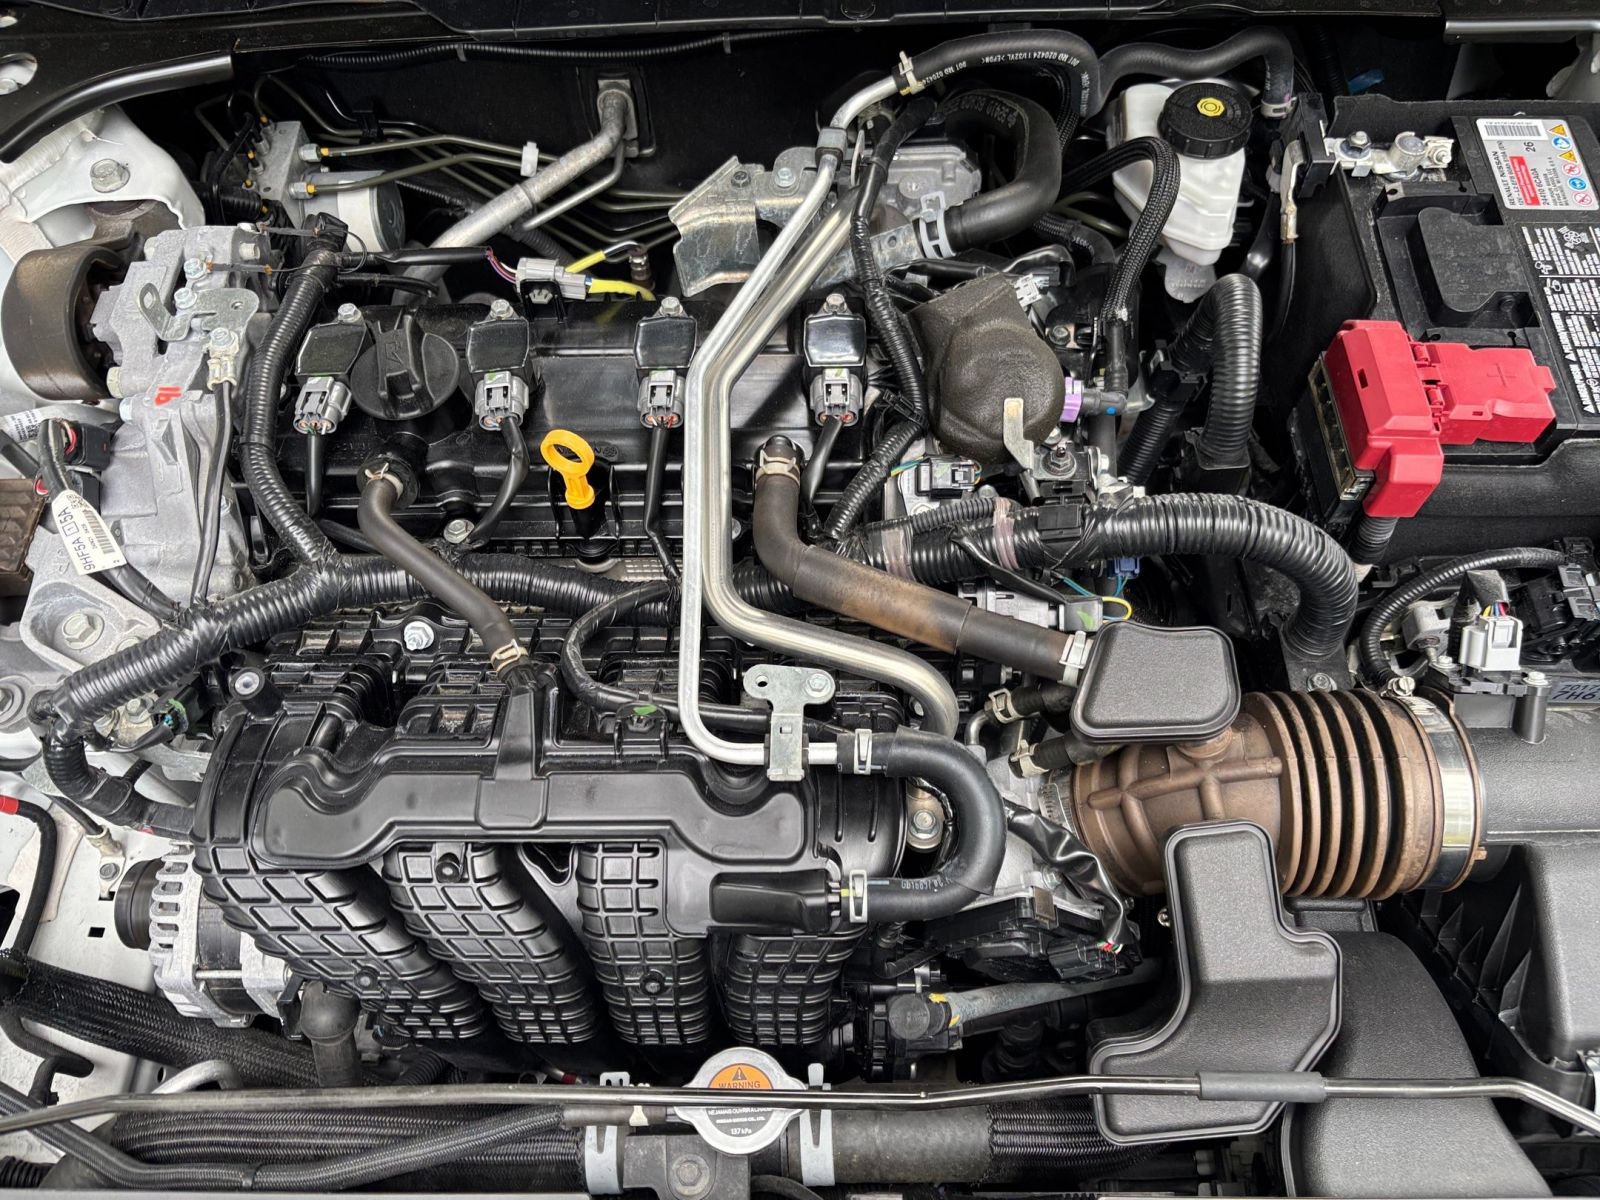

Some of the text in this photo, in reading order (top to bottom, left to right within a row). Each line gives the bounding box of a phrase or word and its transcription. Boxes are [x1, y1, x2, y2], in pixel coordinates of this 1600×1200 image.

[1033, 51, 1058, 59] 020424
[1524, 142, 1536, 152] 26
[1492, 151, 1516, 205] RENAULT NISSAN
[57, 506, 74, 524] 5A
[72, 536, 96, 571] 9HF5A
[1552, 690, 1600, 700] 7H6
[719, 1081, 760, 1089] WARNING
